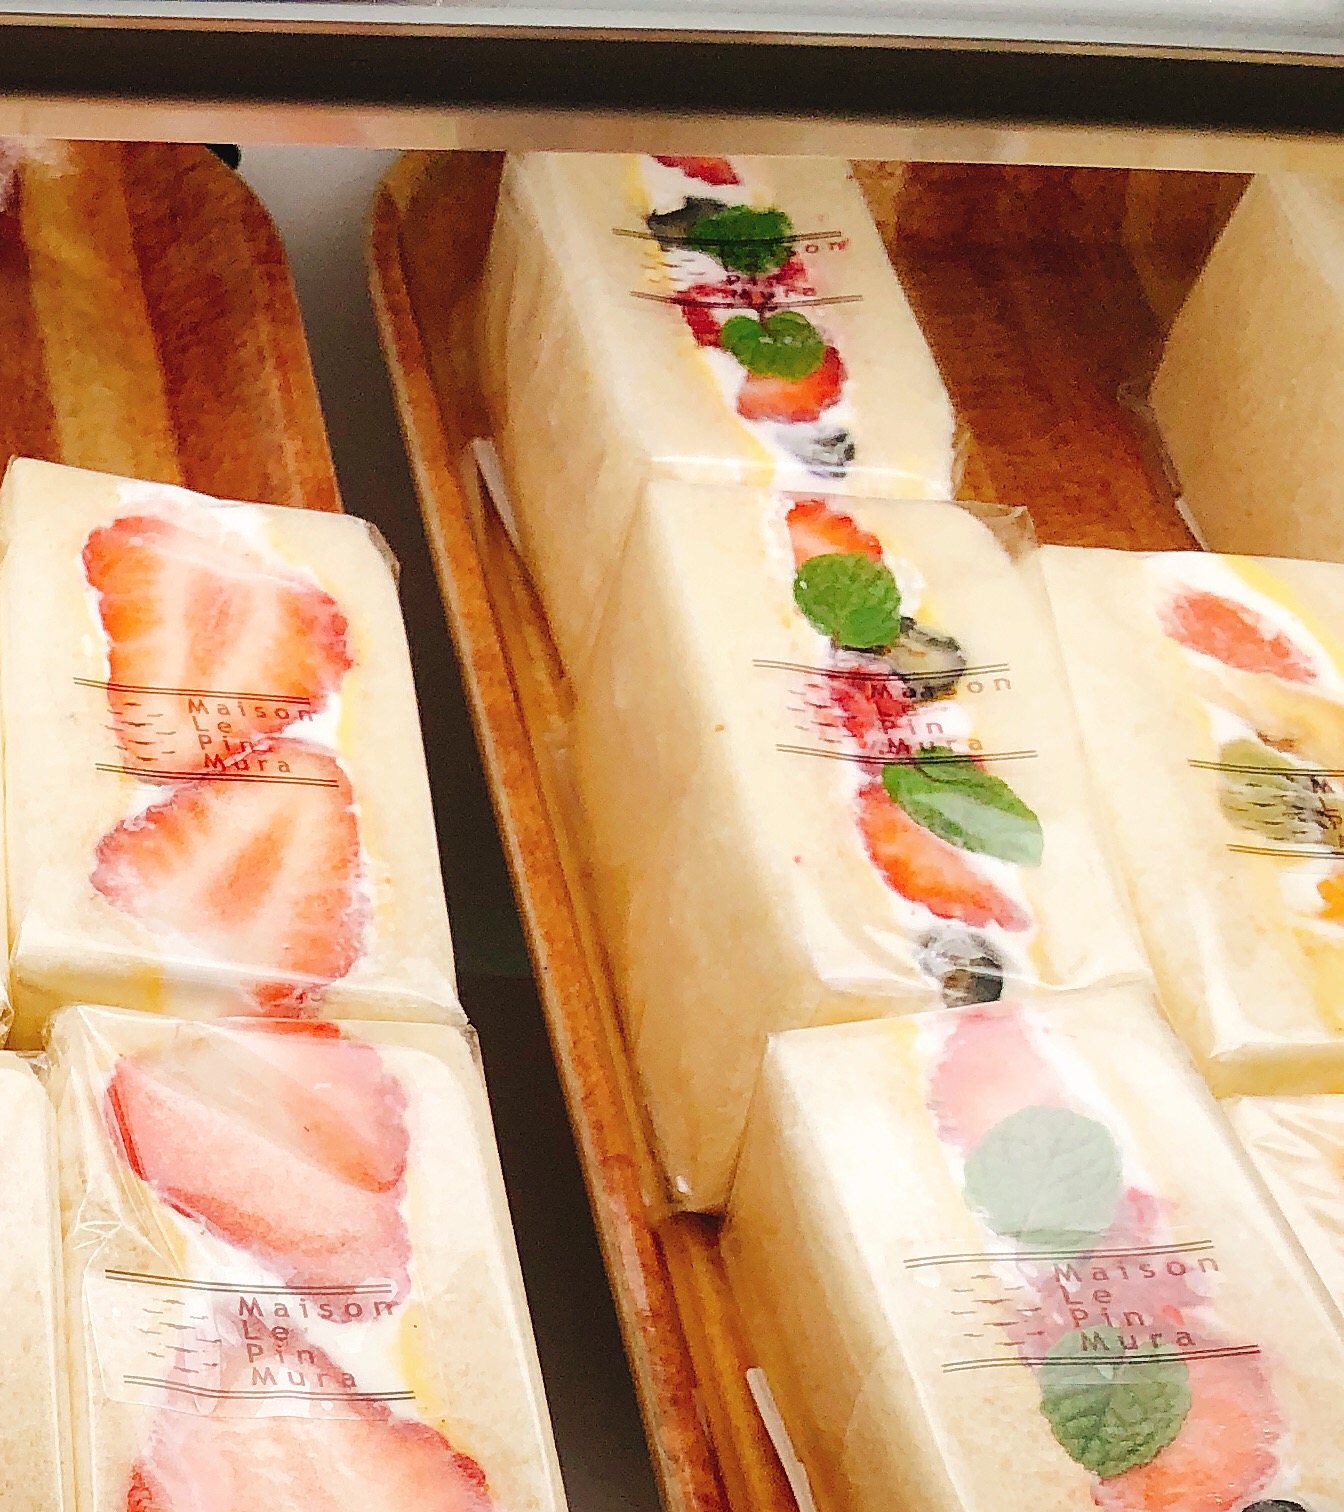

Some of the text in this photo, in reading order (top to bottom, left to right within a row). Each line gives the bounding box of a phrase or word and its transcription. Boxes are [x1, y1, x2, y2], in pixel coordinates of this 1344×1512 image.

[187, 699, 313, 722] Maison
[192, 715, 233, 734] Le
[197, 732, 254, 752] Pin
[203, 752, 292, 773] Mura
[1051, 1256, 1220, 1284] Maison
[1059, 1283, 1112, 1306] Le
[238, 1295, 395, 1319] Maison
[1068, 1306, 1145, 1329] Pin
[241, 1318, 290, 1341] Le
[1079, 1329, 1196, 1352] Mura
[245, 1341, 315, 1365] Pin
[250, 1365, 359, 1389] Mura
